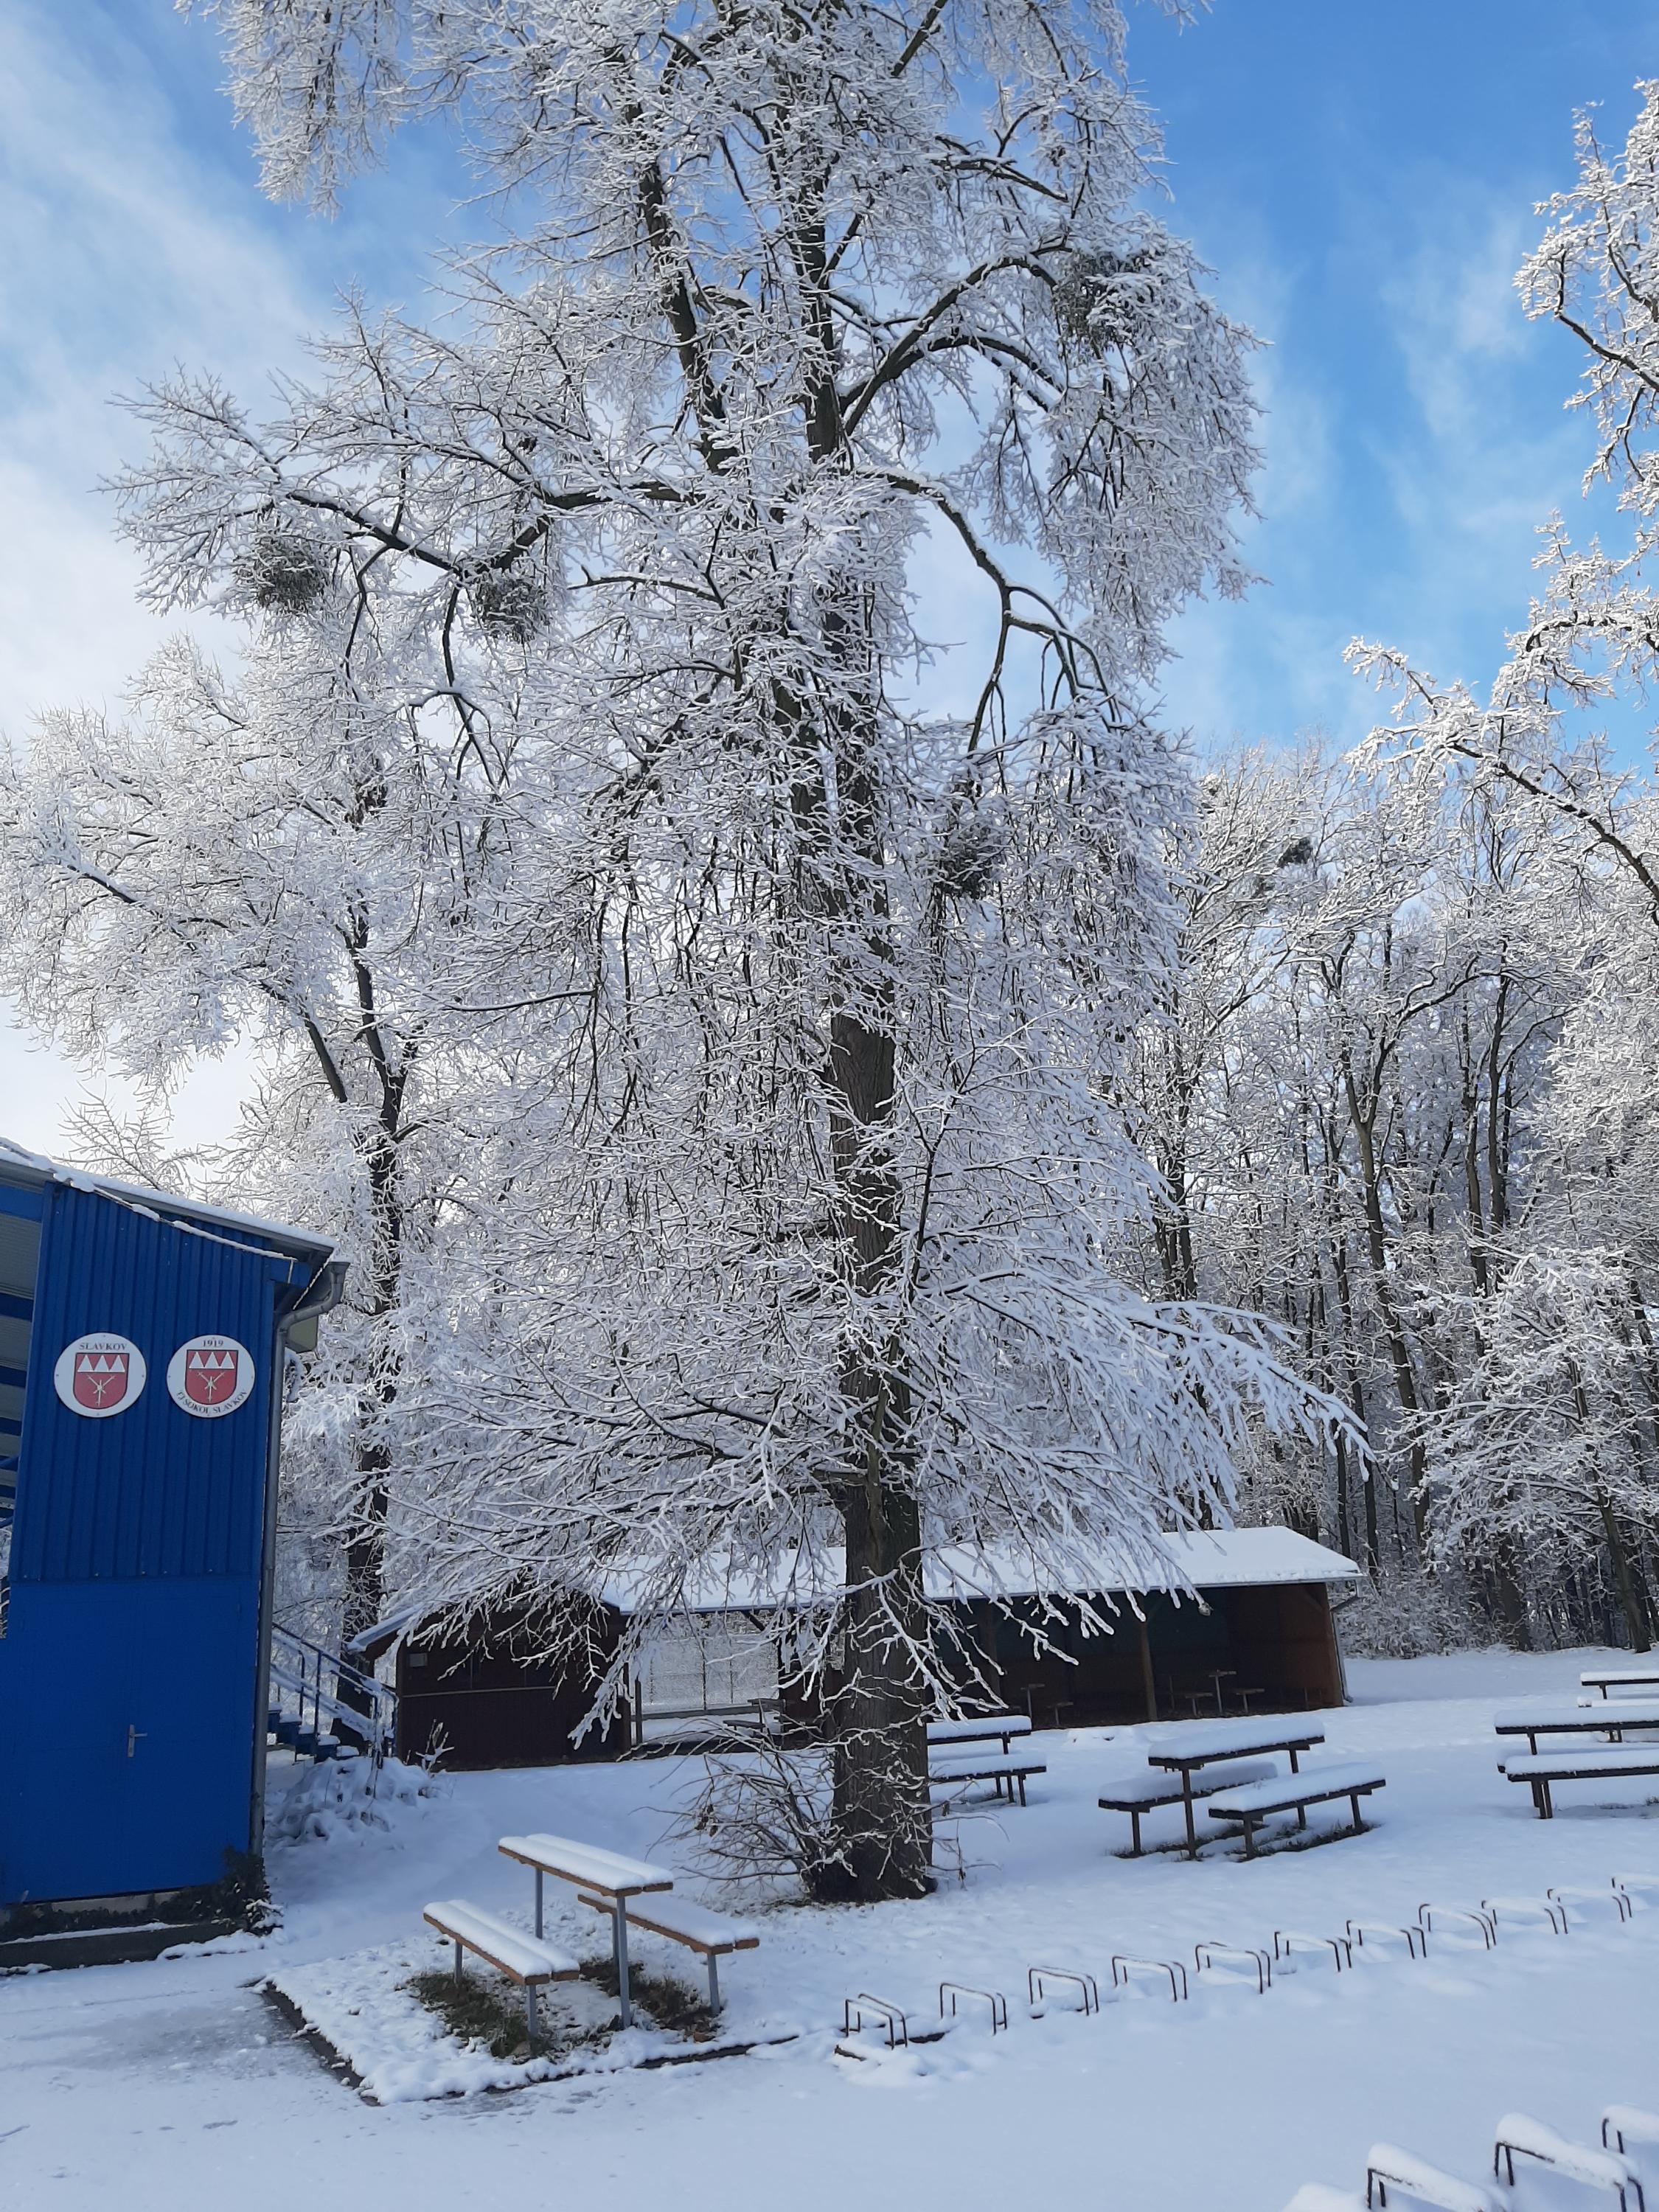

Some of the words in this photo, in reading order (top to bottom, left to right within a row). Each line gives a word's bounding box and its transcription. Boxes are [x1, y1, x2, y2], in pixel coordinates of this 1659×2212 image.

[79, 1342, 128, 1351] SLAVKOV
[183, 1399, 210, 1413] SOKOL
[213, 1391, 248, 1413] SLAVKOV
